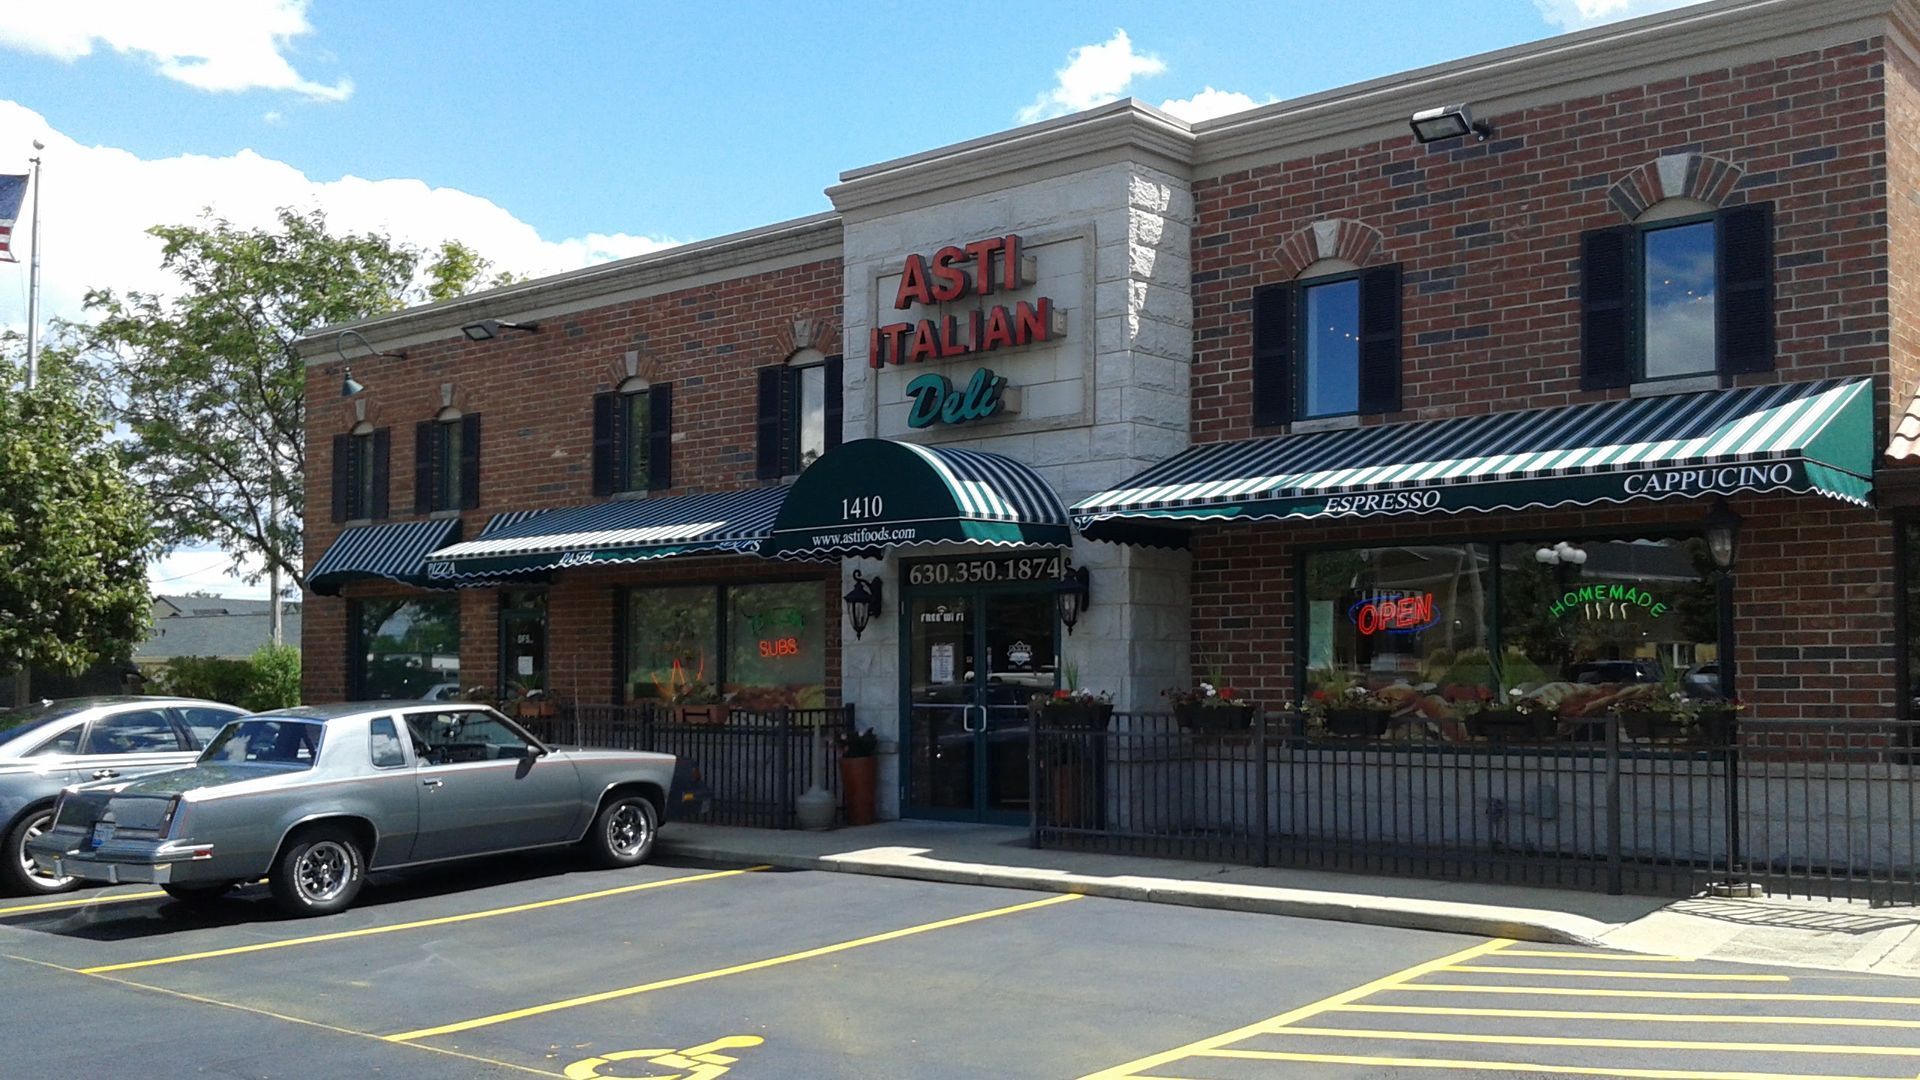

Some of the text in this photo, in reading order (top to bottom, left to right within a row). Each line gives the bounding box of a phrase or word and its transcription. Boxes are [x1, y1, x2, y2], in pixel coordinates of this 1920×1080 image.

[895, 234, 1020, 309] ASTI
[869, 297, 1051, 368] ITALIAN
[906, 367, 1005, 428] Deli
[1623, 463, 1793, 494] CAPPUCINO
[842, 495, 883, 520] 1410
[1323, 490, 1441, 513] ESPRESSO
[812, 526, 916, 546] www.astifoods.com
[428, 562, 456, 577] PIZZA
[909, 557, 1060, 585] 630.350.1874
[1358, 592, 1432, 635] OPEN
[1549, 584, 1668, 618] HOMEMADE
[759, 638, 799, 657] SUBS
